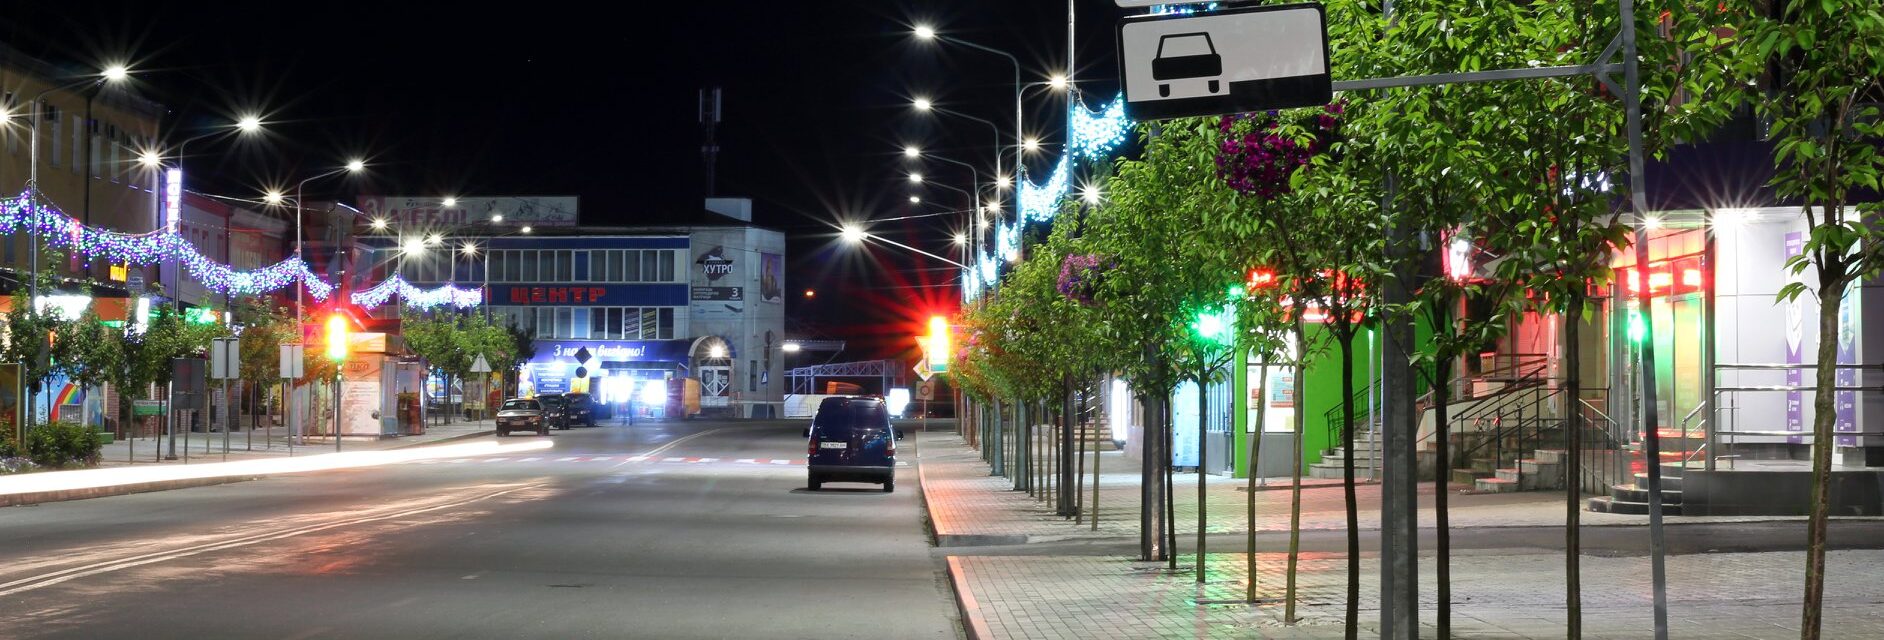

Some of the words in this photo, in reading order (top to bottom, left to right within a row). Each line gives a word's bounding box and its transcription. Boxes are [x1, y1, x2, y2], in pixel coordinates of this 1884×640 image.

[704, 264, 733, 273] ХУТРО
[511, 287, 605, 304] ЦЕНТР
[732, 288, 738, 297] 3
[563, 347, 597, 357] наи
